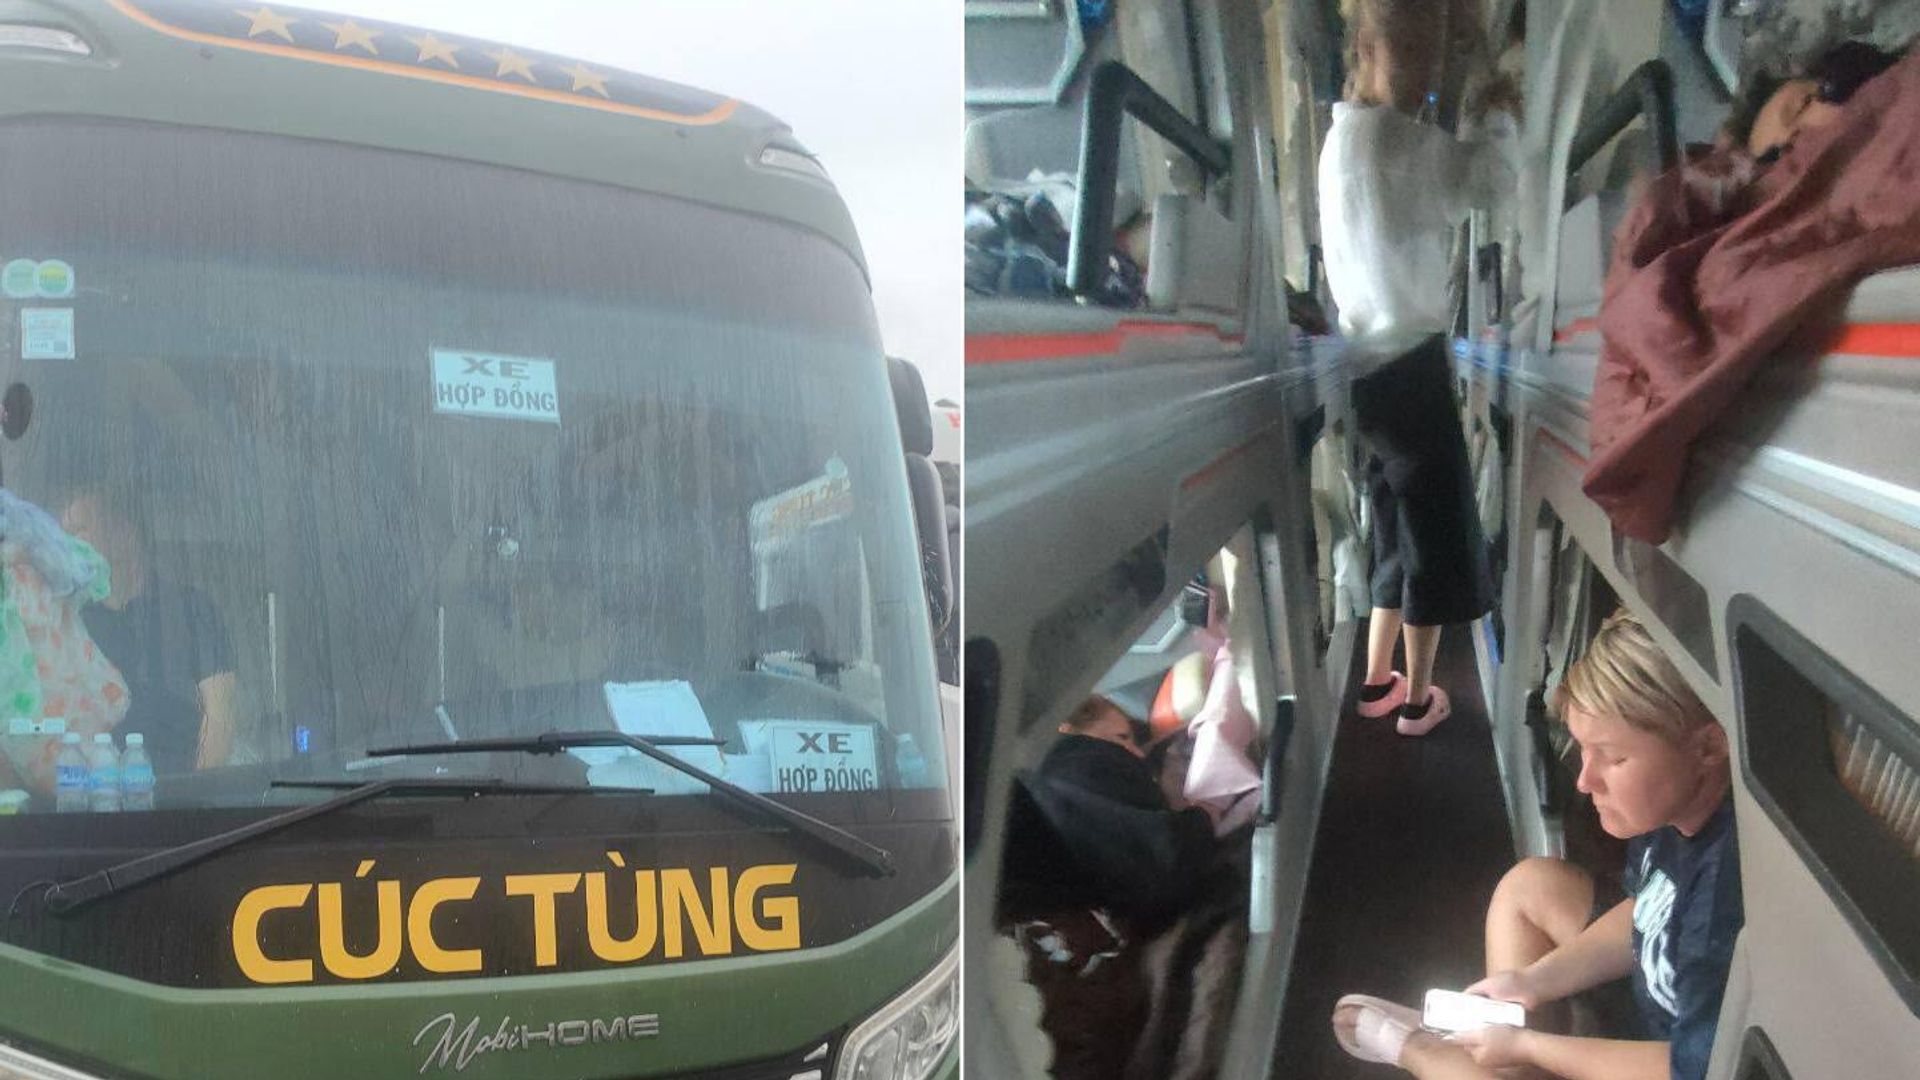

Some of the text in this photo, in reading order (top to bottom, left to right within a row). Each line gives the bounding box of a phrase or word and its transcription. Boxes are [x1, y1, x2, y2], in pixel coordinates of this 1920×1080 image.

[461, 357, 531, 381] XE
[439, 382, 486, 409] HỢP
[797, 732, 854, 754] XE
[232, 851, 801, 983] CÚC TÙNG
